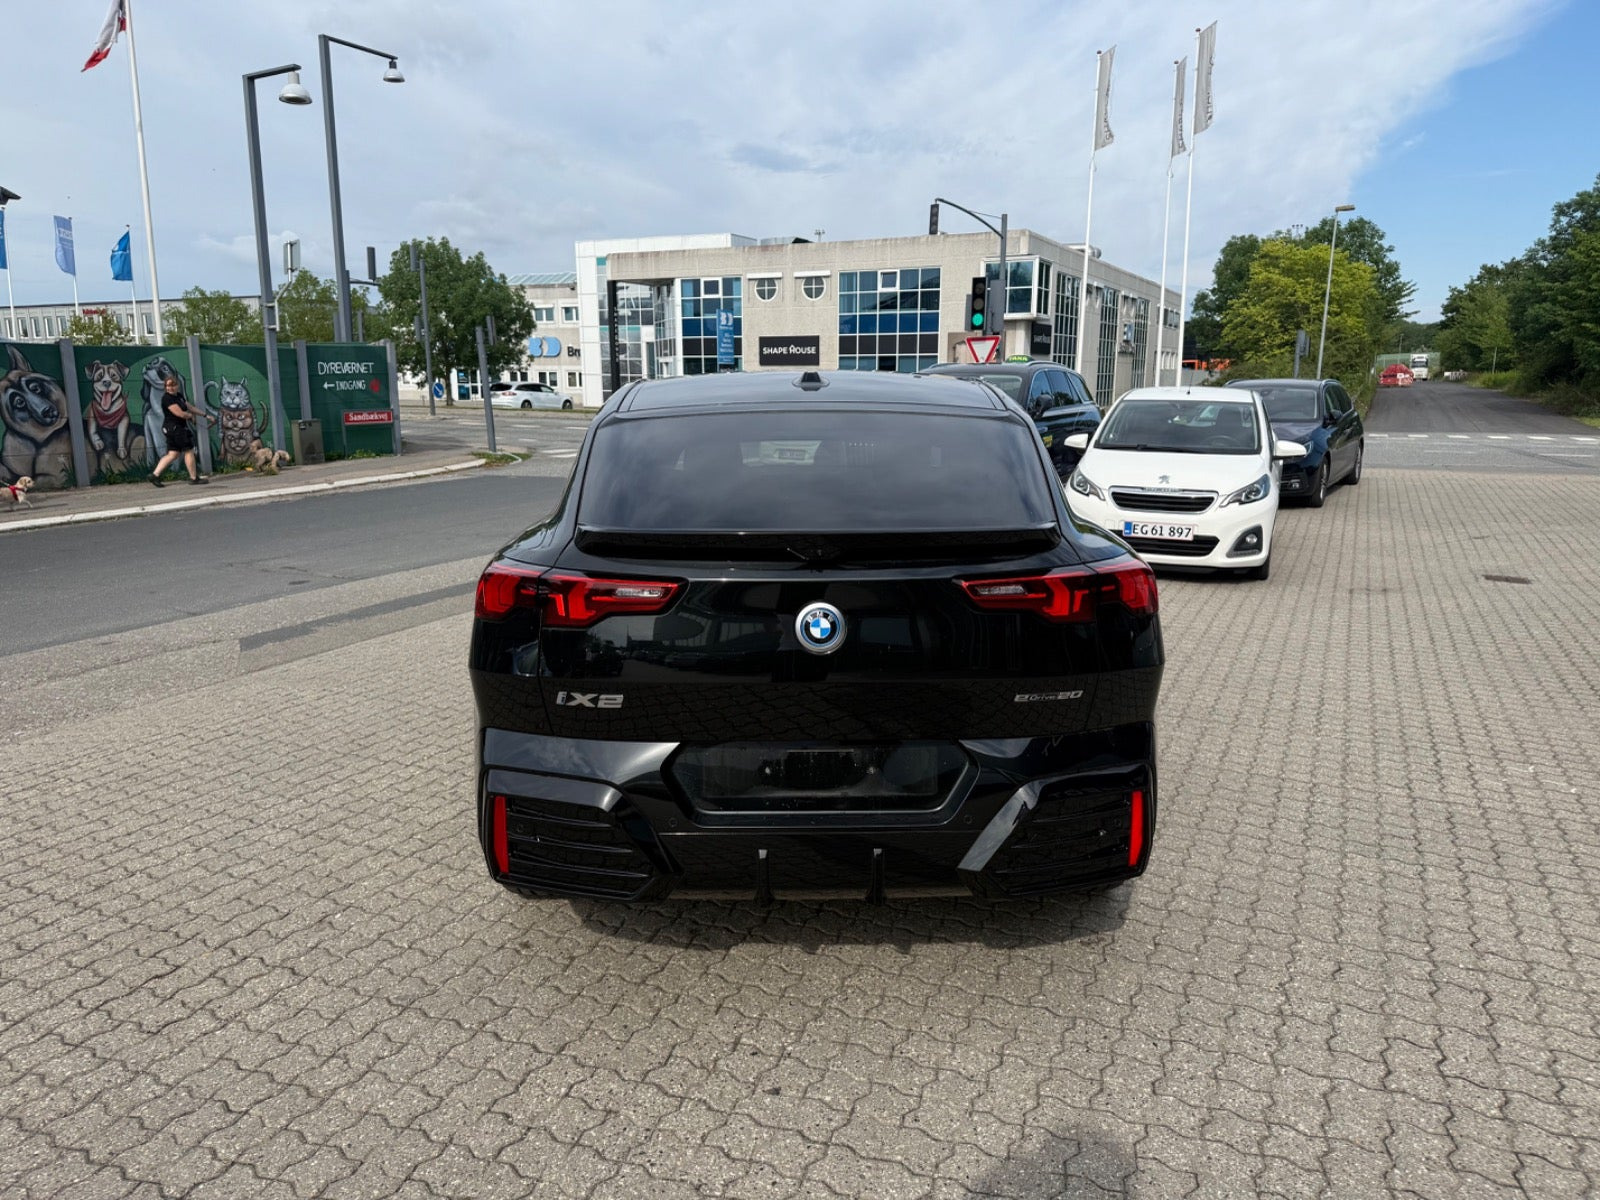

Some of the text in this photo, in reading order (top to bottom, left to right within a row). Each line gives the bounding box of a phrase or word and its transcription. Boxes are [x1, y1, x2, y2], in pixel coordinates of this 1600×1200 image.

[762, 344, 817, 355] SHAPE HOUSE
[317, 361, 375, 375] DYREVÆRNET
[335, 380, 366, 391] INDGANG
[348, 412, 388, 422] Sandbækvej
[1132, 524, 1192, 538] EG 61 897
[556, 691, 624, 709] iX2
